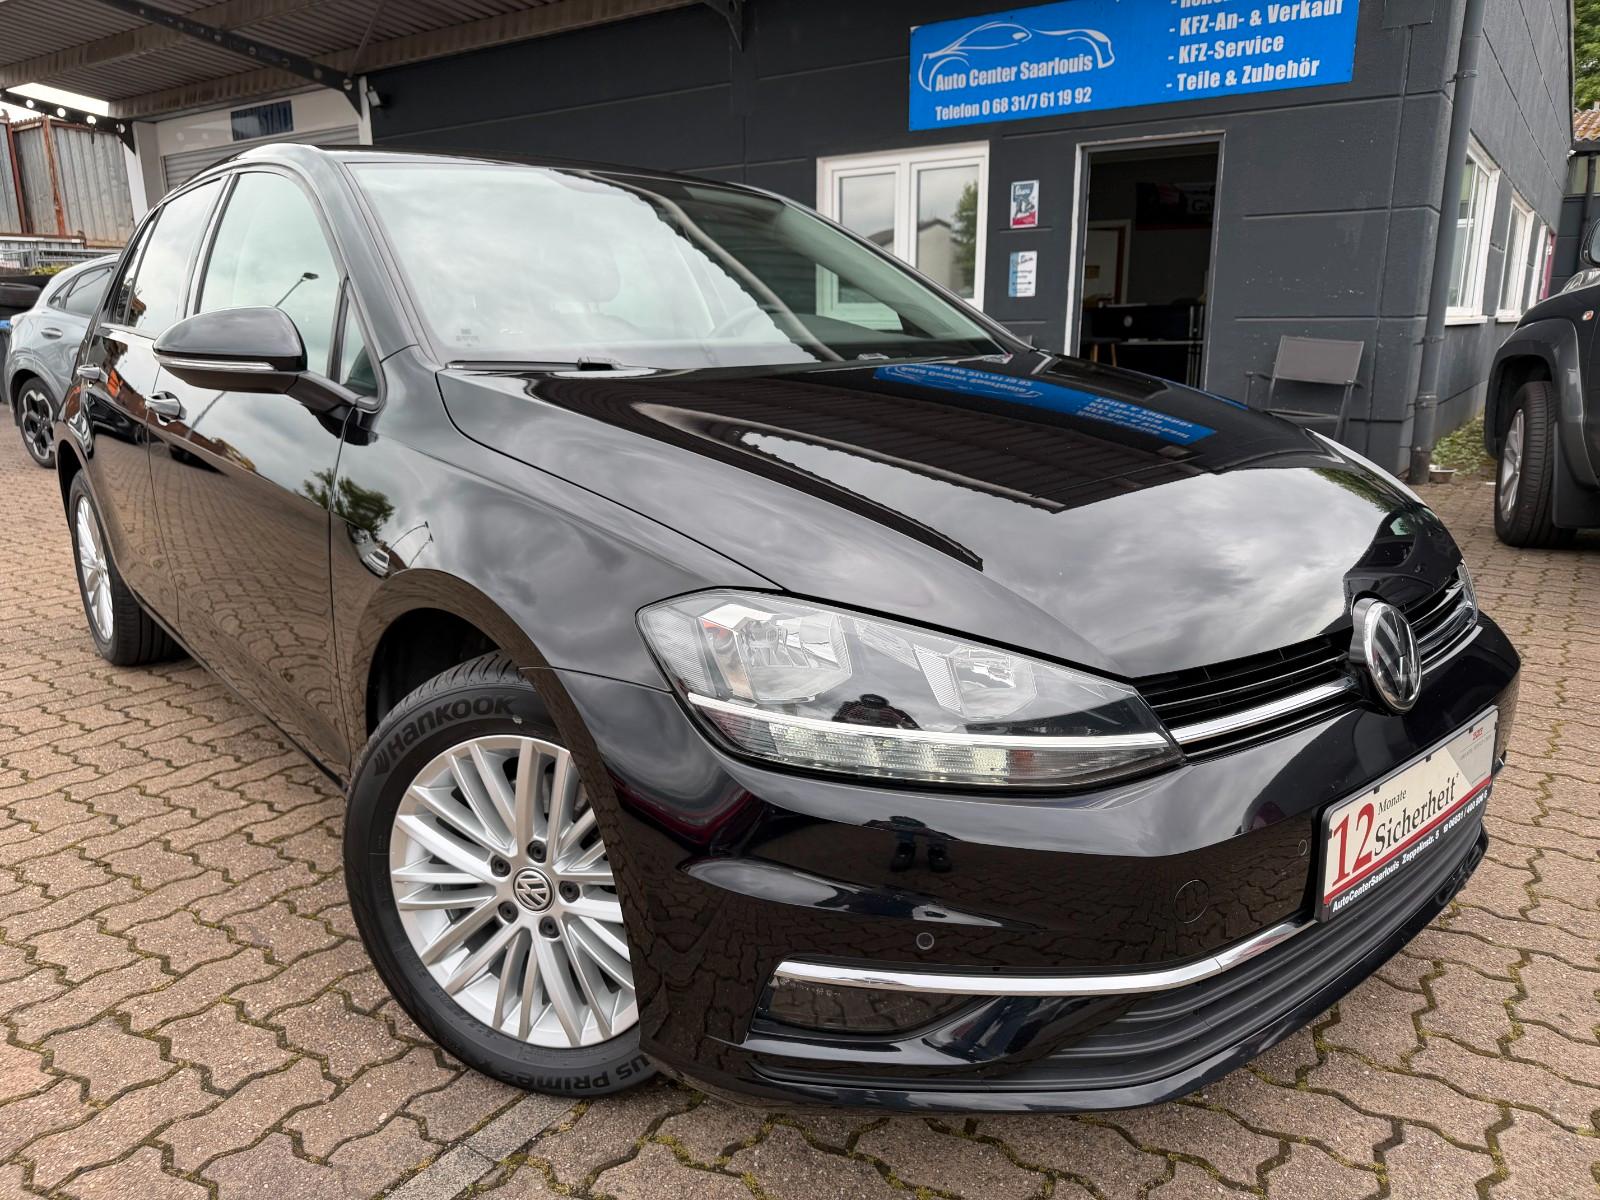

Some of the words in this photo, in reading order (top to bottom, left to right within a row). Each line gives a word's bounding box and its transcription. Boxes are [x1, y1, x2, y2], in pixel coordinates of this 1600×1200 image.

[1179, 12, 1245, 37] KFZ-An-
[1249, 9, 1262, 26] &
[1267, 0, 1343, 24] Verkauf
[1178, 35, 1285, 65] KFZ-Service
[935, 73, 967, 92] Auto
[969, 65, 1018, 88] Center
[1020, 53, 1093, 80] Saarlouis
[1176, 70, 1221, 92] Teile
[1225, 69, 1238, 87] &
[1241, 57, 1321, 85] Zubehör
[935, 102, 980, 122] Telefon
[982, 99, 991, 116] 0
[992, 96, 1009, 114] 68
[1011, 93, 1038, 112] 31/7
[1040, 91, 1055, 108] 61
[1057, 88, 1072, 106] 19
[1074, 86, 1093, 104] 92
[1377, 789, 1407, 816] Monate
[1332, 802, 1375, 888] 12
